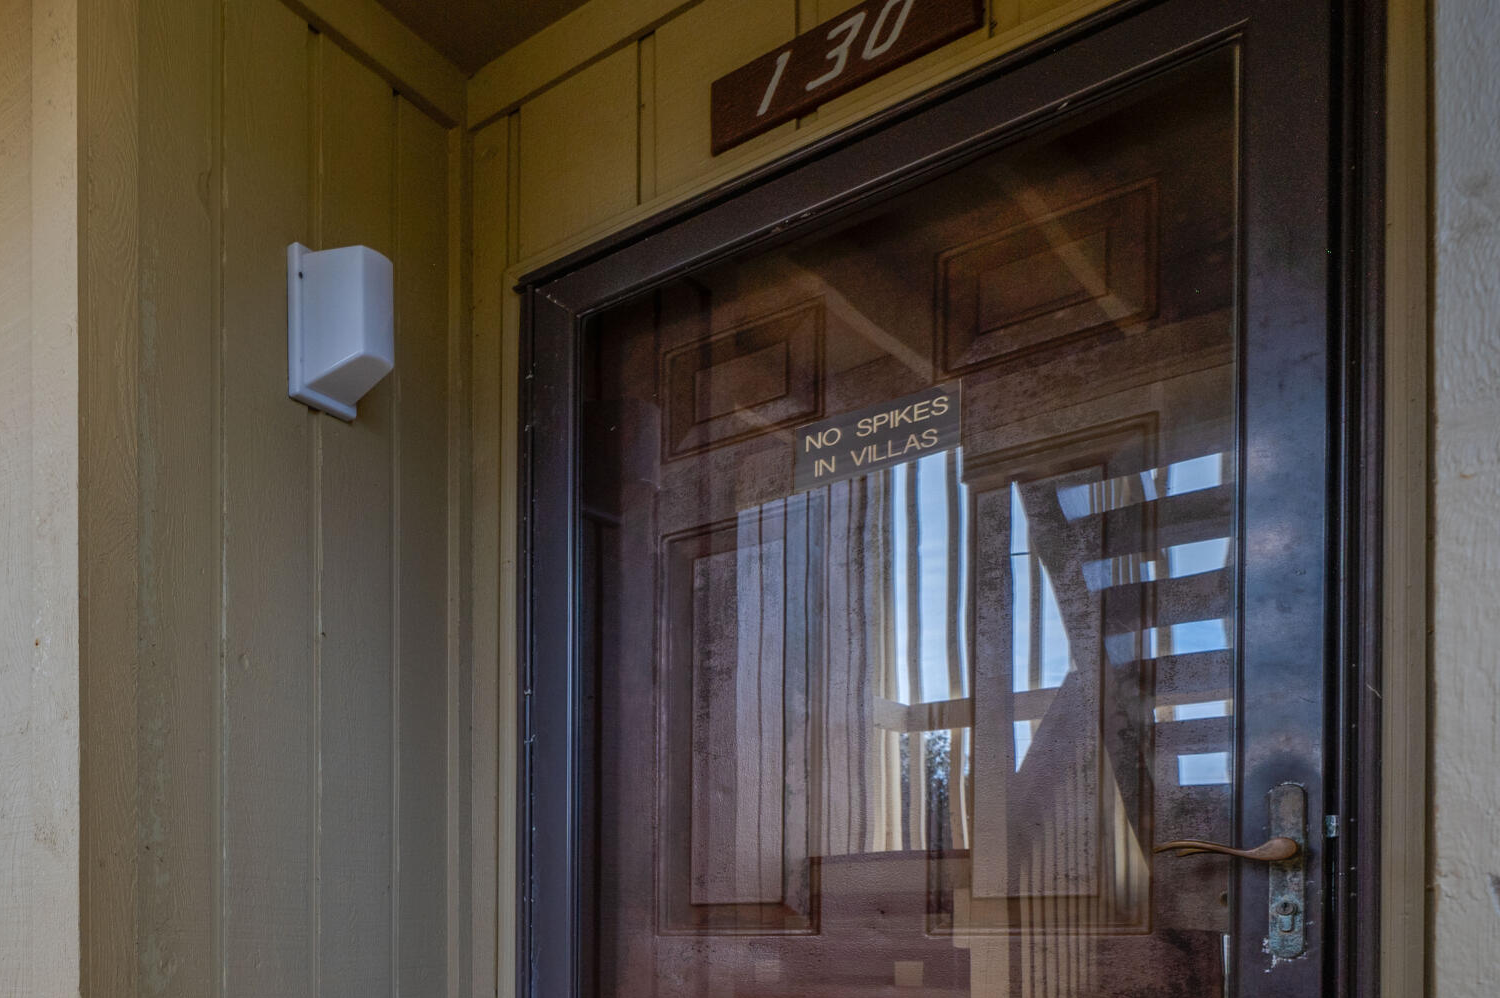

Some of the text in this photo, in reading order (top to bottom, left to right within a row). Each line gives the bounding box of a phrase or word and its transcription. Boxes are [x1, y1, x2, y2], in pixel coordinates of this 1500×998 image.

[756, 0, 915, 117] 130
[805, 395, 950, 453] NO SPIKES
[814, 428, 939, 478] IN VILLAS
